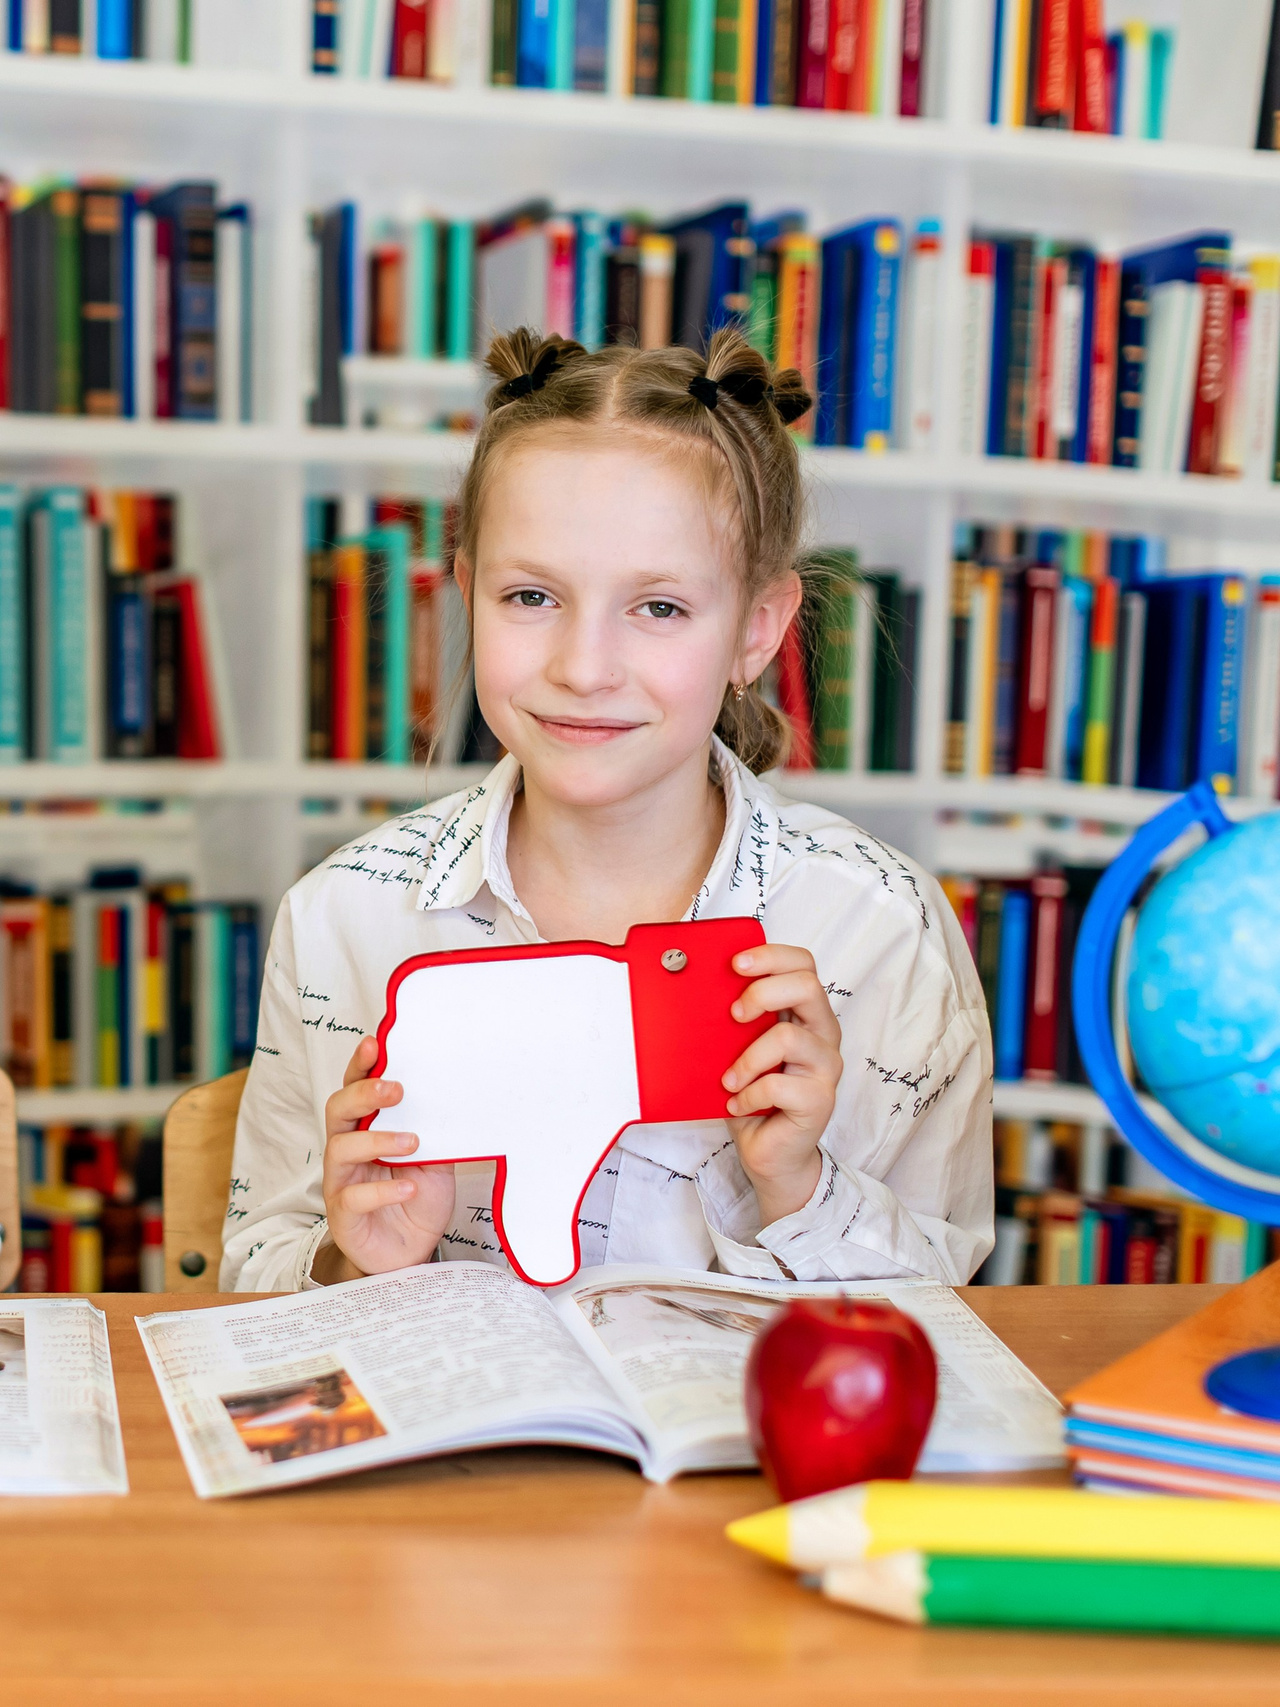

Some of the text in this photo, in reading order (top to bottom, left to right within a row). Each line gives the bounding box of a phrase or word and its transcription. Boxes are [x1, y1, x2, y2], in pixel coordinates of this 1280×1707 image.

[750, 807, 770, 834] life
[449, 824, 483, 871] Happiness
[750, 834, 770, 850] of
[749, 852, 770, 888] method
[326, 1016, 364, 1036] dreams
[466, 1205, 494, 1224] The
[480, 1240, 496, 1252] in
